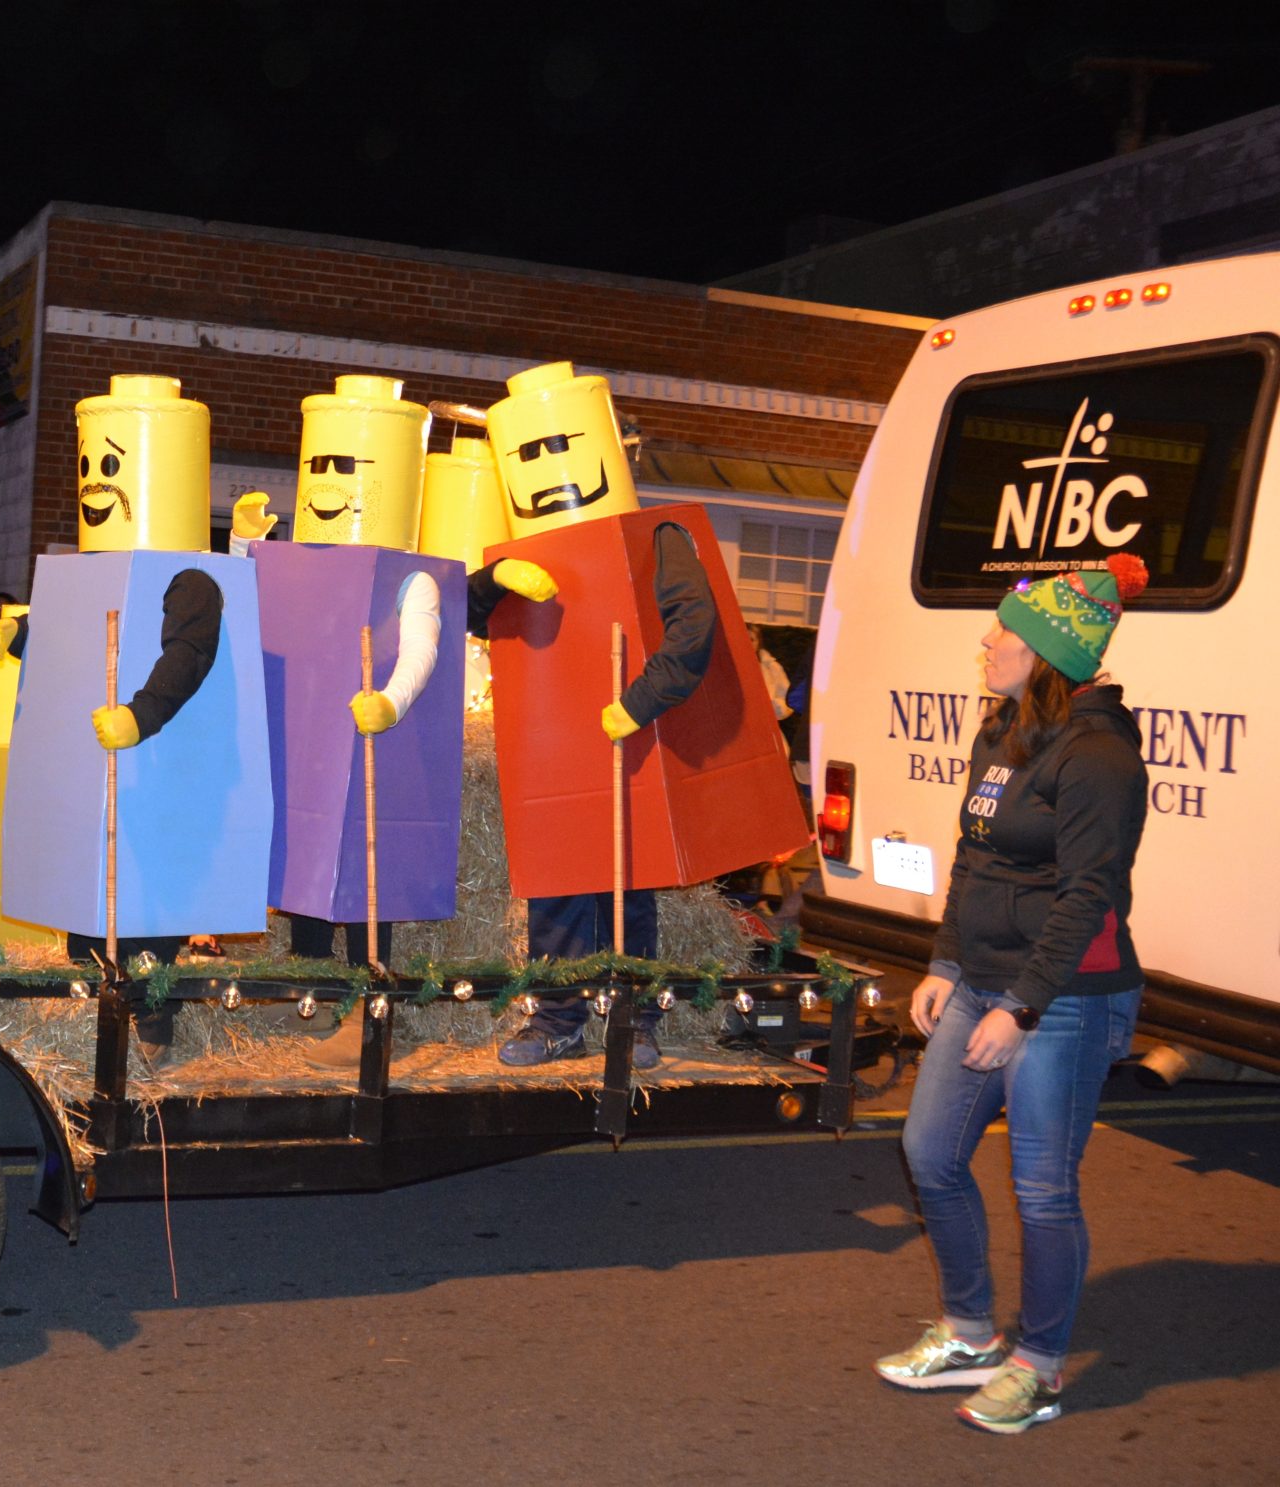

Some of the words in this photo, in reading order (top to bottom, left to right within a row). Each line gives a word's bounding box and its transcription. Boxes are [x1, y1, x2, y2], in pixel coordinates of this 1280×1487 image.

[988, 561, 1021, 572] CHURCH
[1022, 561, 1034, 571] ON
[1035, 560, 1067, 571] MISSION
[1068, 560, 1081, 571] TO
[1081, 560, 1097, 570] WIN
[888, 690, 968, 746] NEW
[982, 765, 1014, 785] RUN
